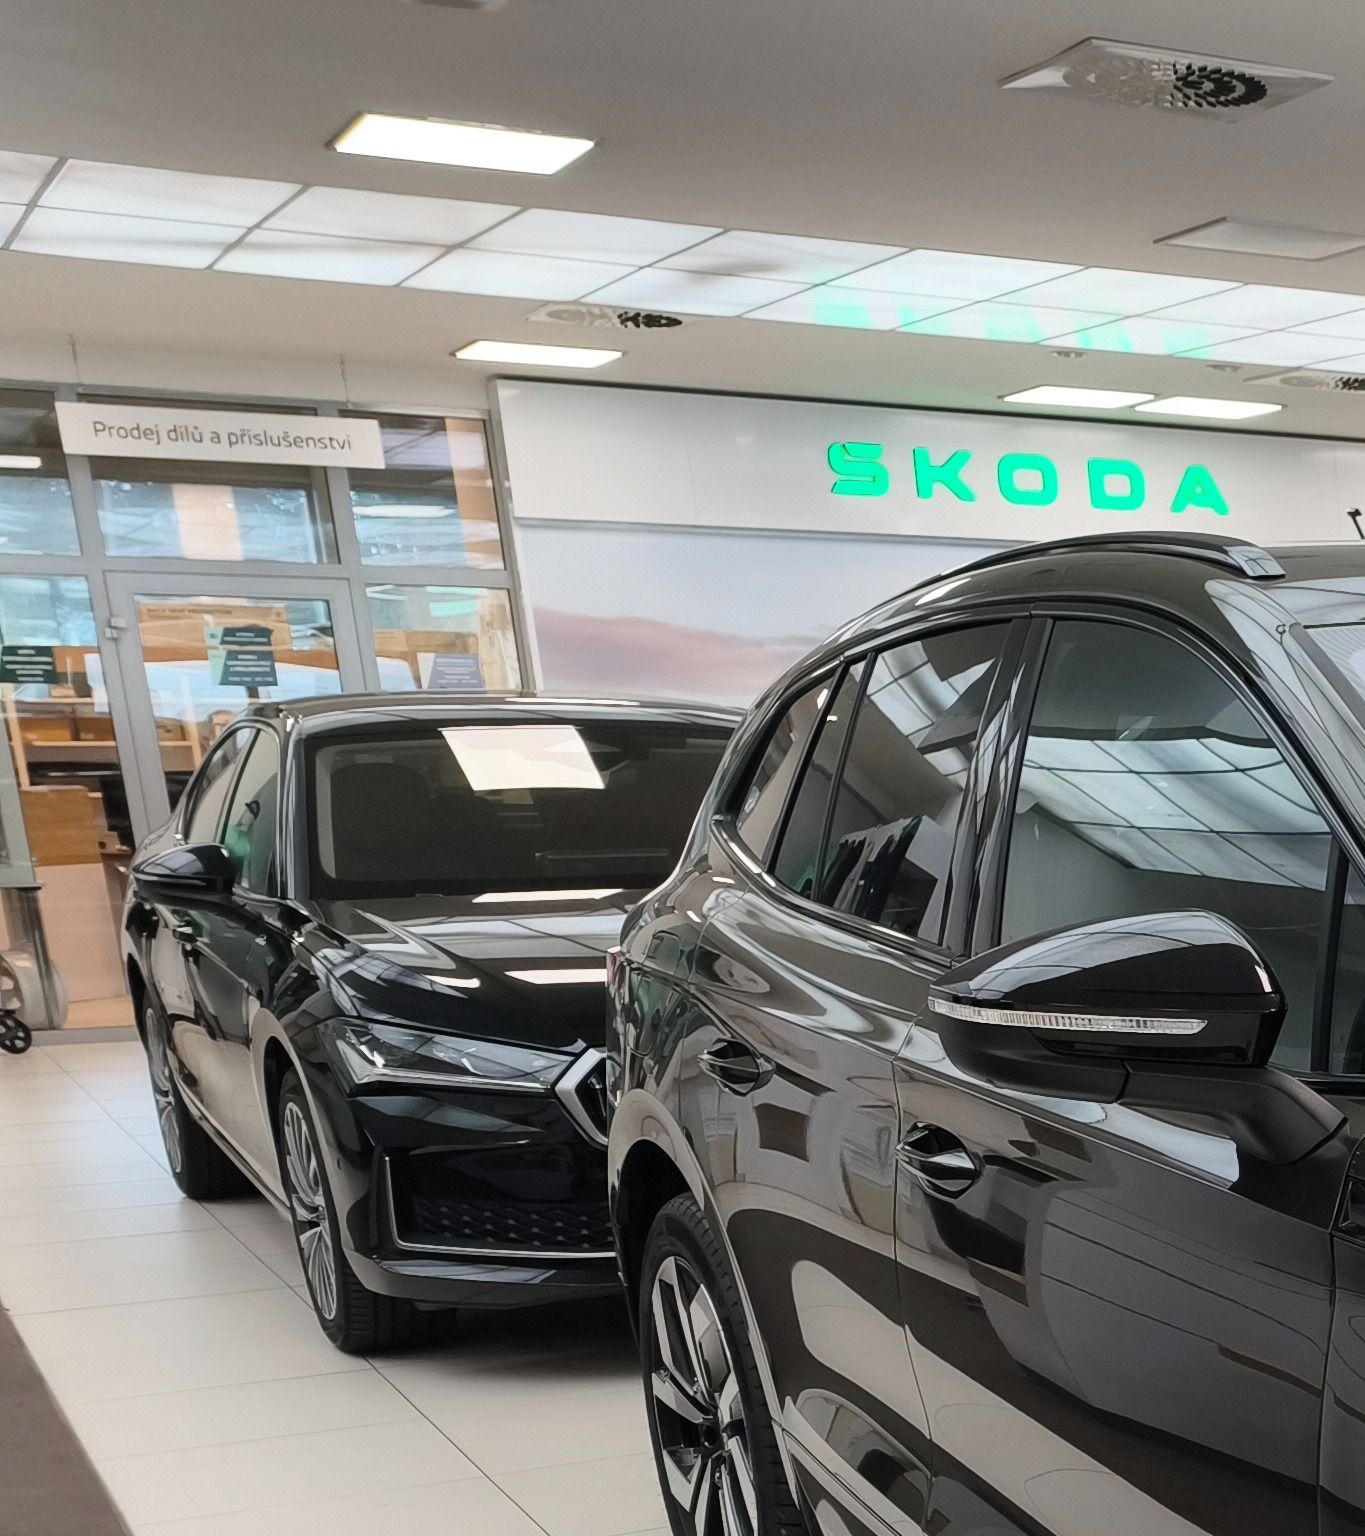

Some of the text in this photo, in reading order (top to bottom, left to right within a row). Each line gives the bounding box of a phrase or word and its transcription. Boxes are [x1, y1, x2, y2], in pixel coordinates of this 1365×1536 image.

[92, 420, 352, 451] Prodej dílů a příslušenství
